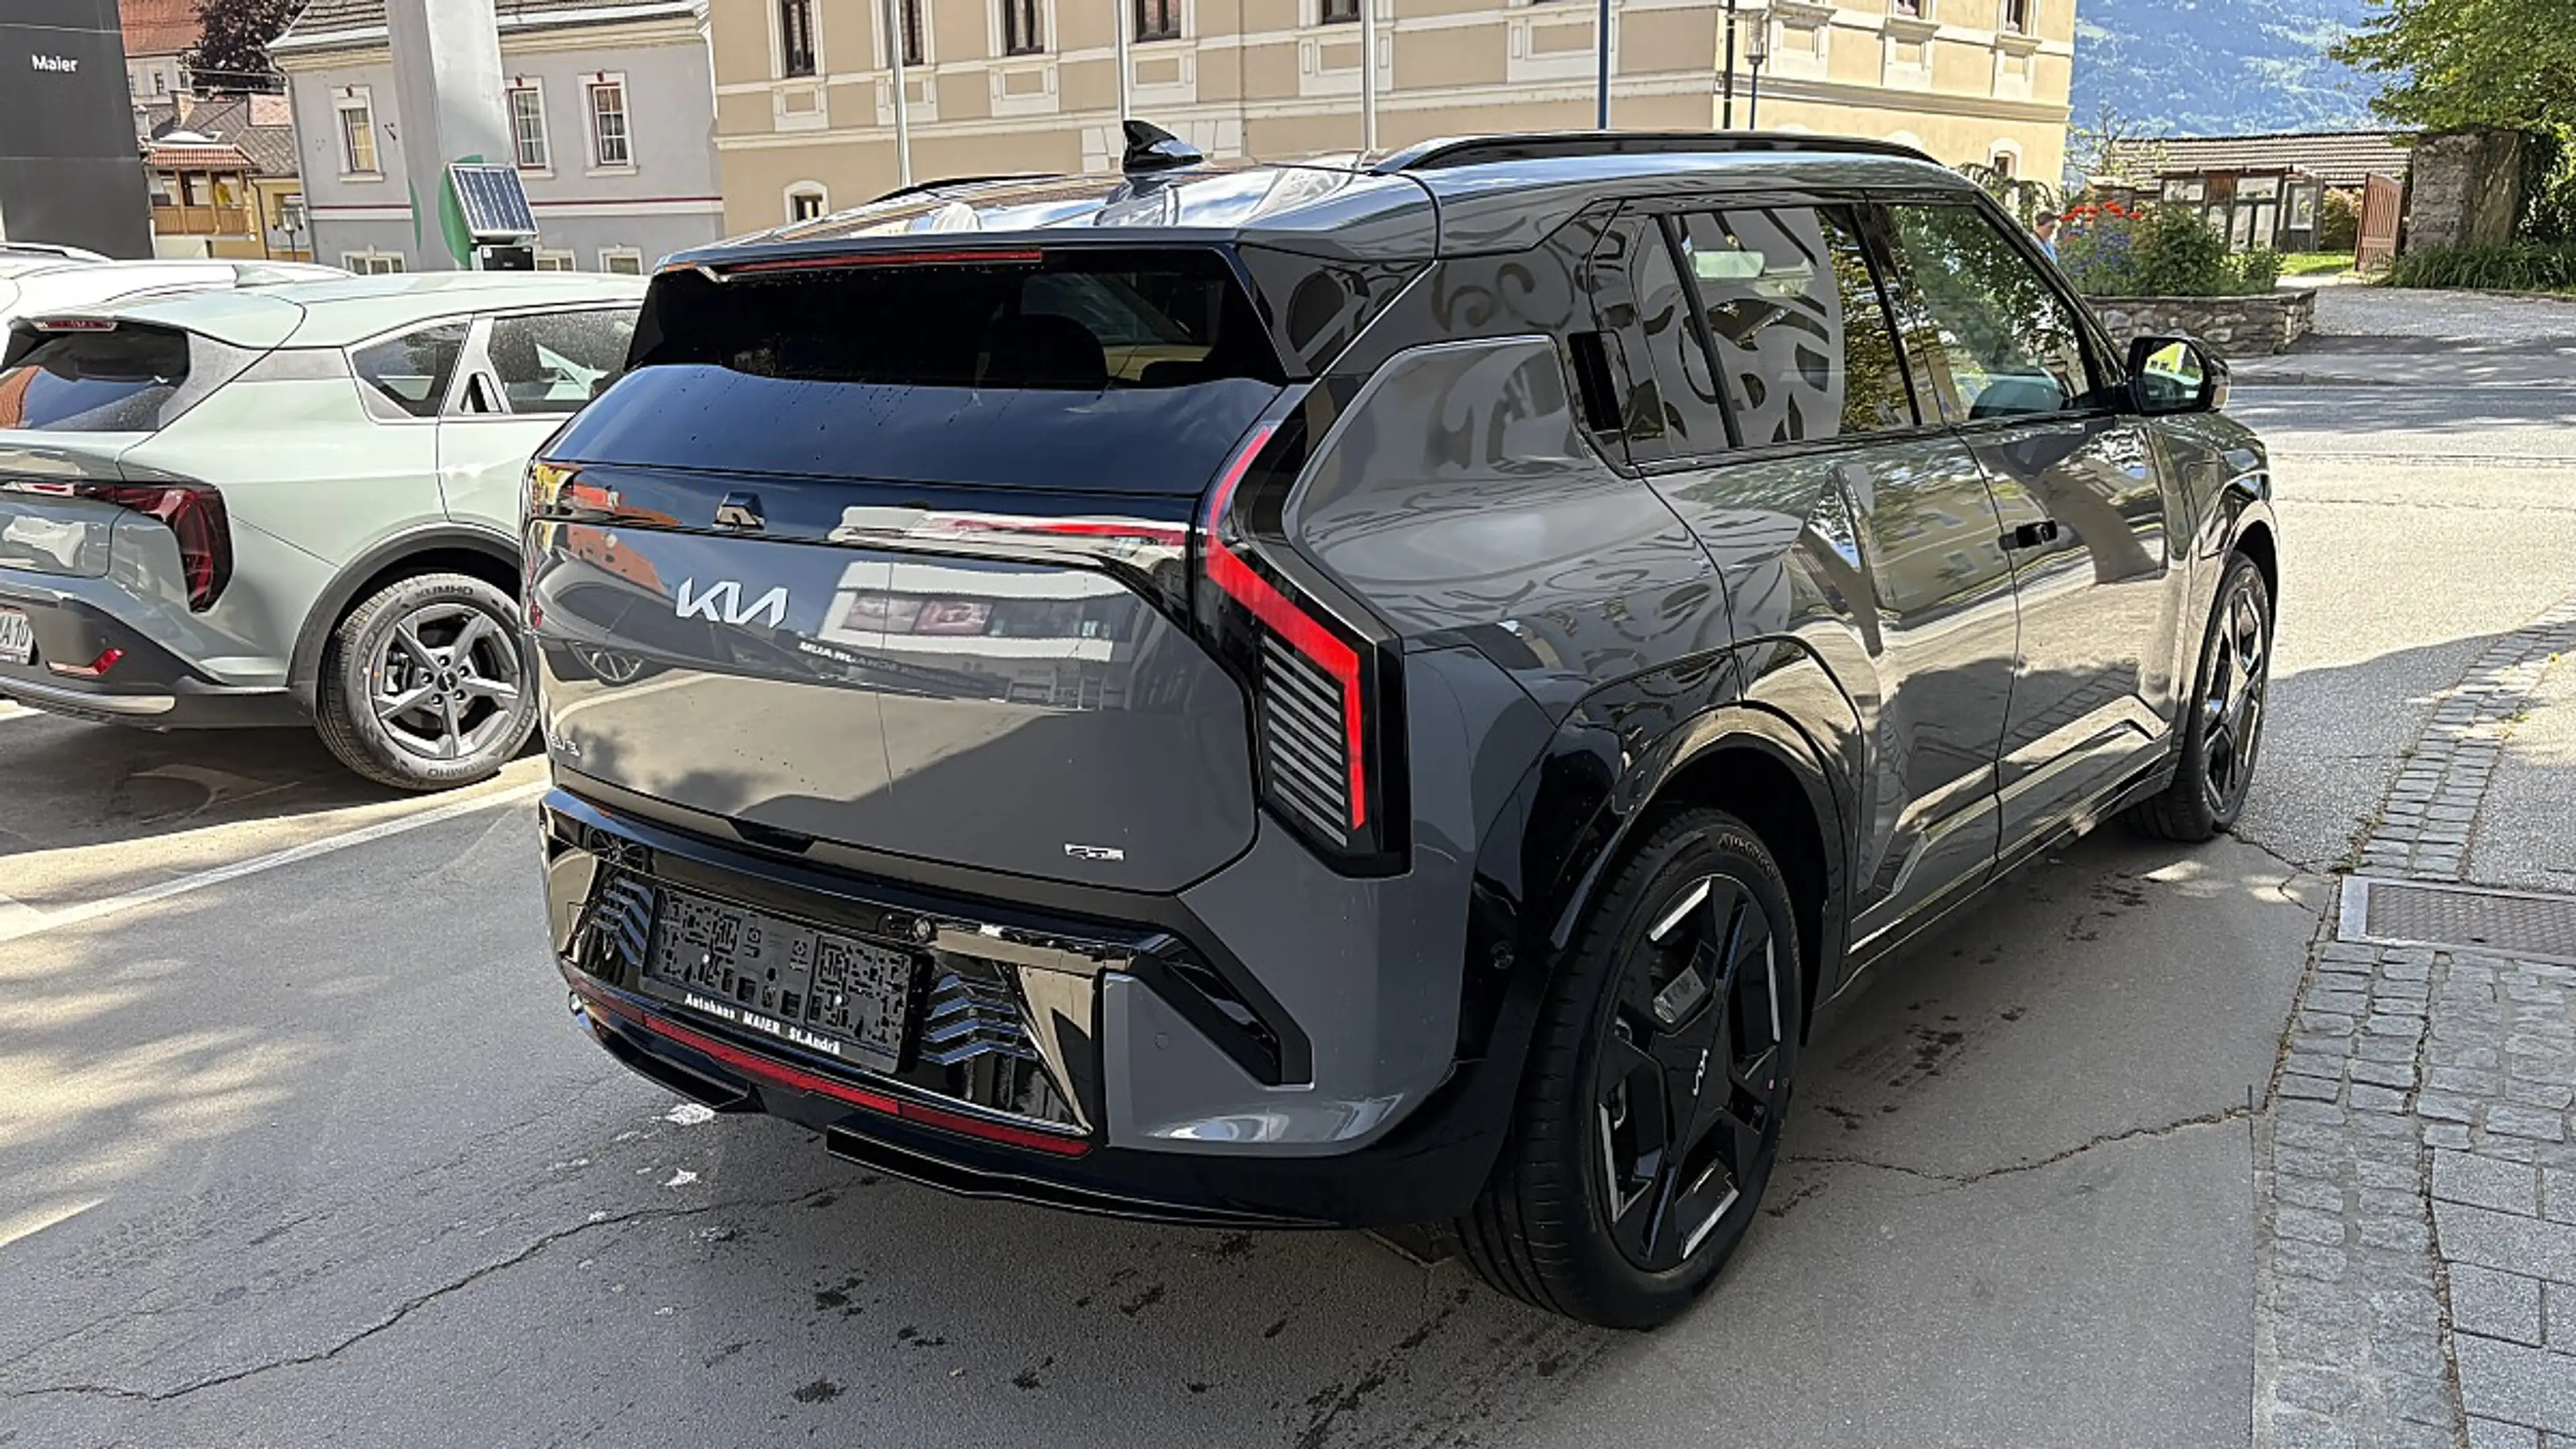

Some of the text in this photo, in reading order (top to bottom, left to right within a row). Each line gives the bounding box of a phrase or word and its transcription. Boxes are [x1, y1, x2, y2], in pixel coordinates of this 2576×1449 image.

[32, 54, 78, 72] Maier
[676, 578, 788, 628] KIA
[684, 993, 735, 1020] Autohaus
[743, 1011, 781, 1035] MAIER
